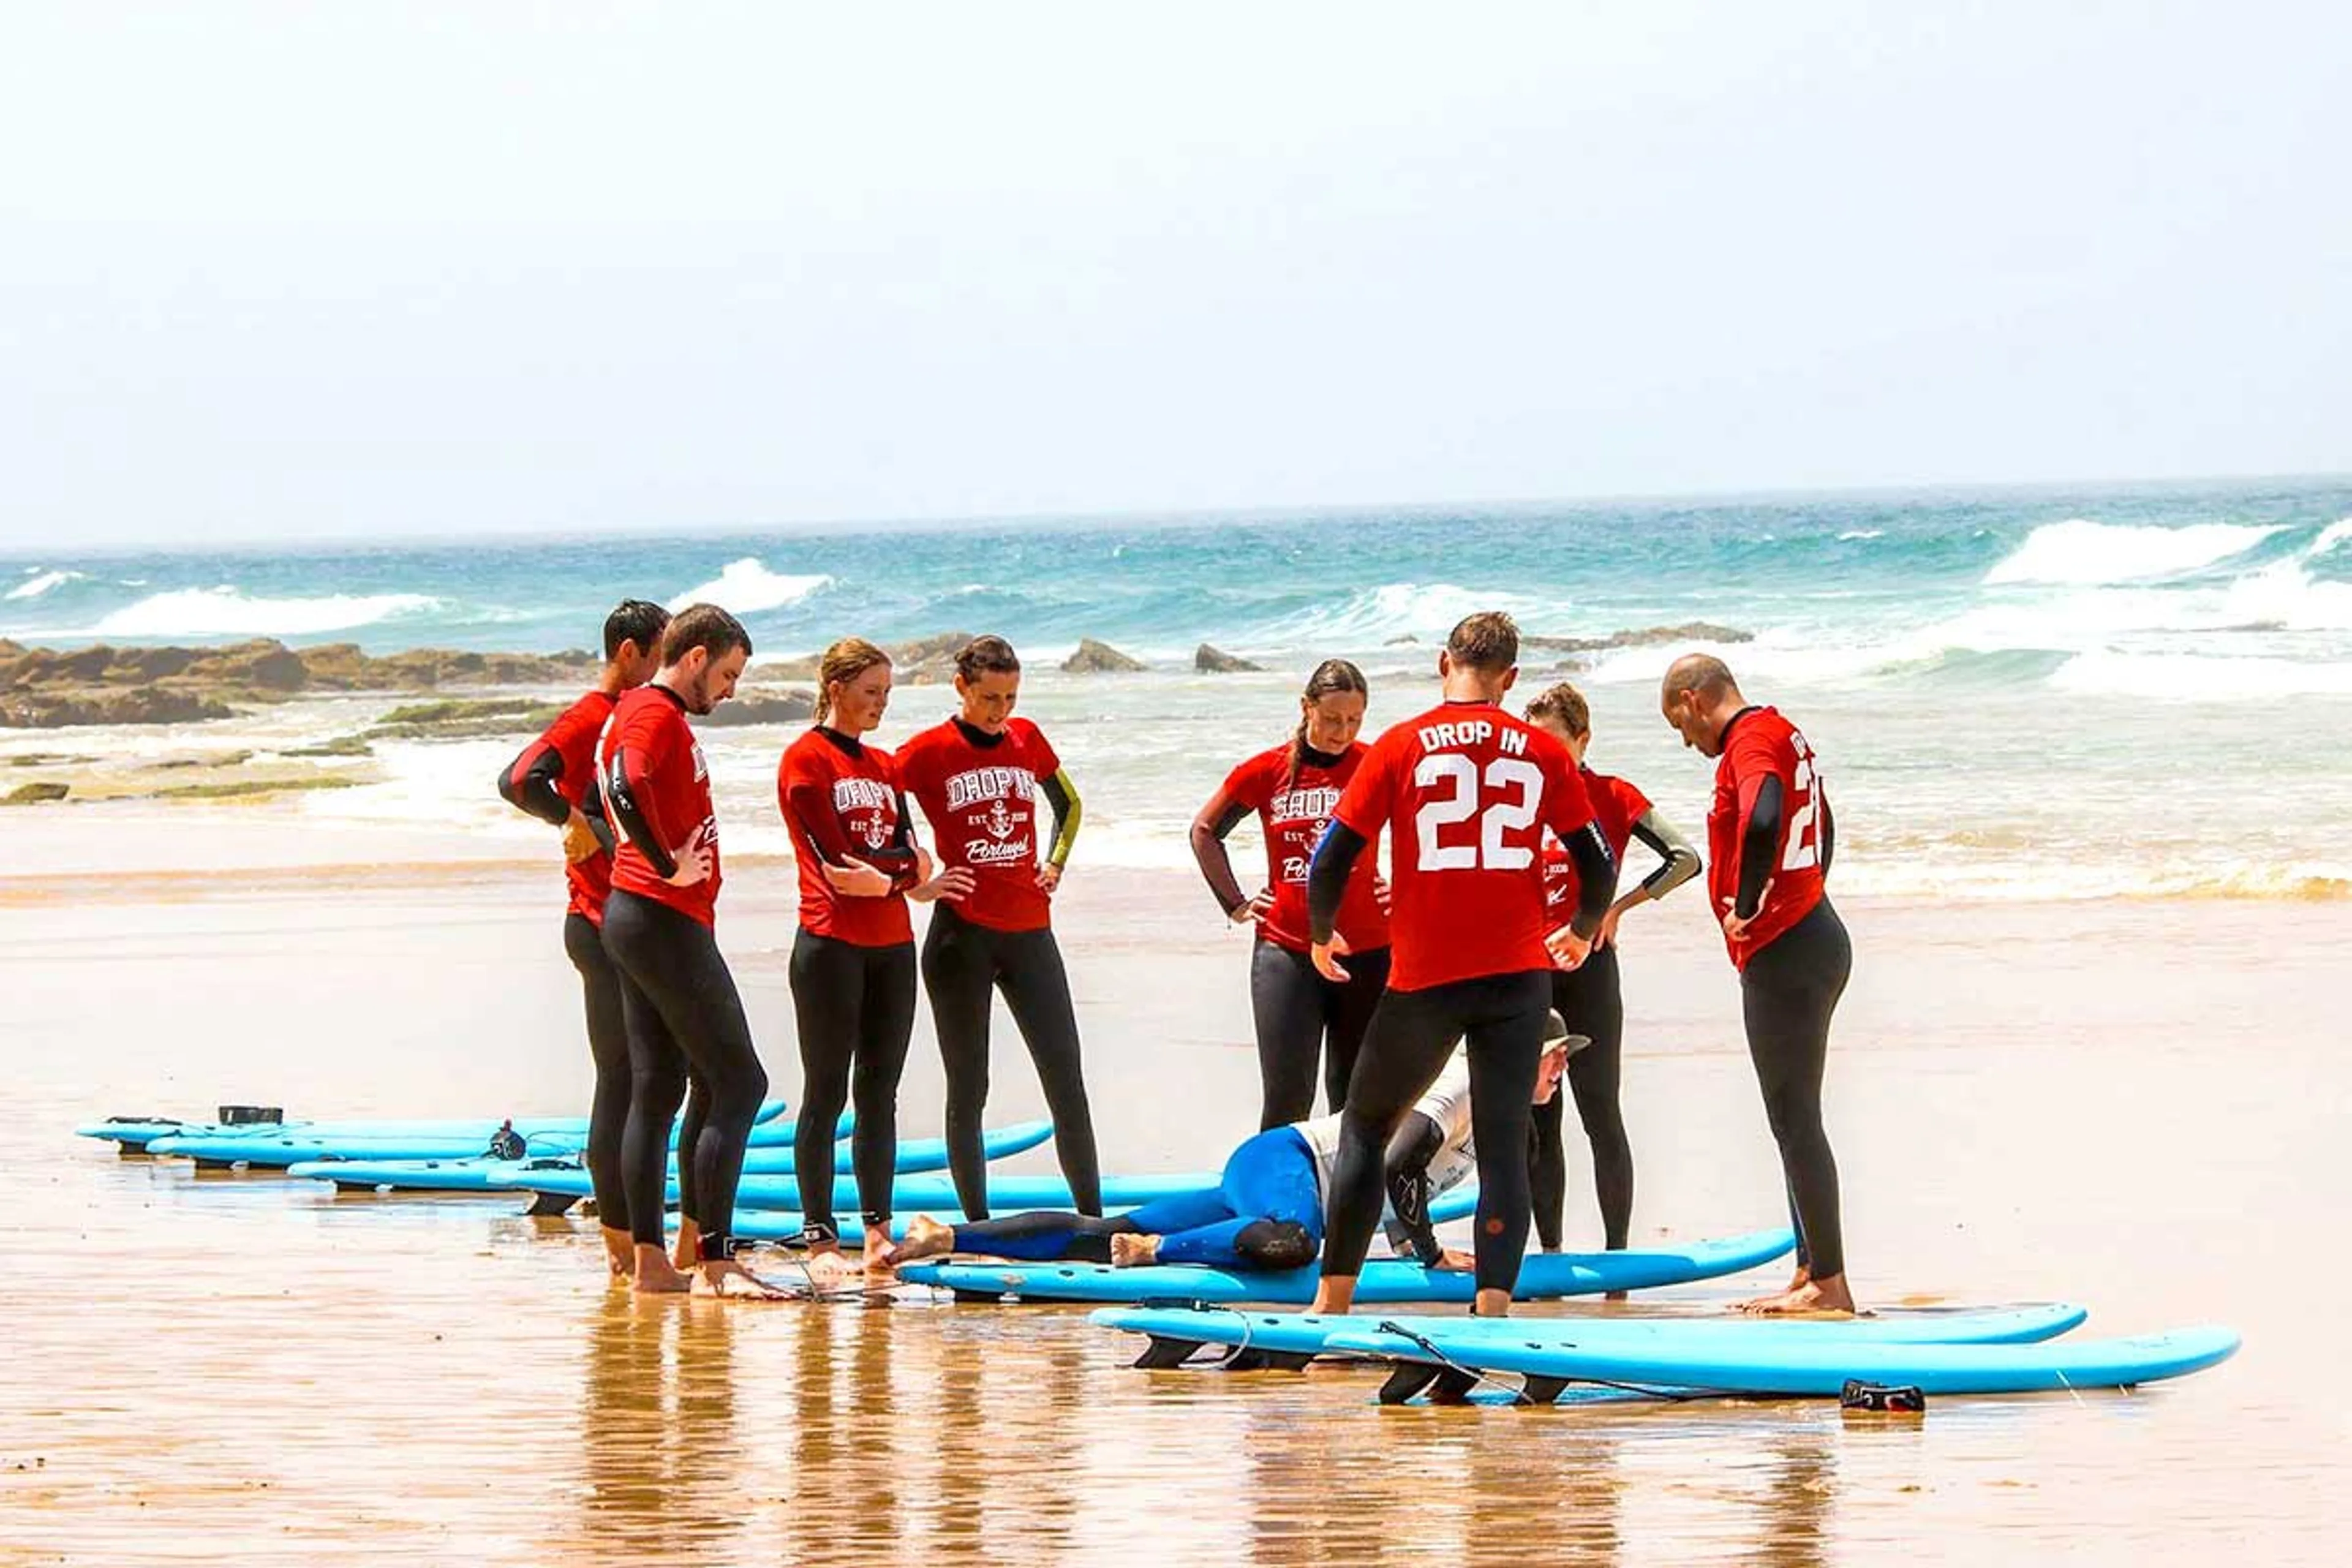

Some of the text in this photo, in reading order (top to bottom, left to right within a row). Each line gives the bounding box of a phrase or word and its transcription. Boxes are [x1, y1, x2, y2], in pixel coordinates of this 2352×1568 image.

[1419, 720, 1528, 756] DROP IN
[945, 766, 1011, 812] DROP
[1414, 753, 1545, 872] 22
